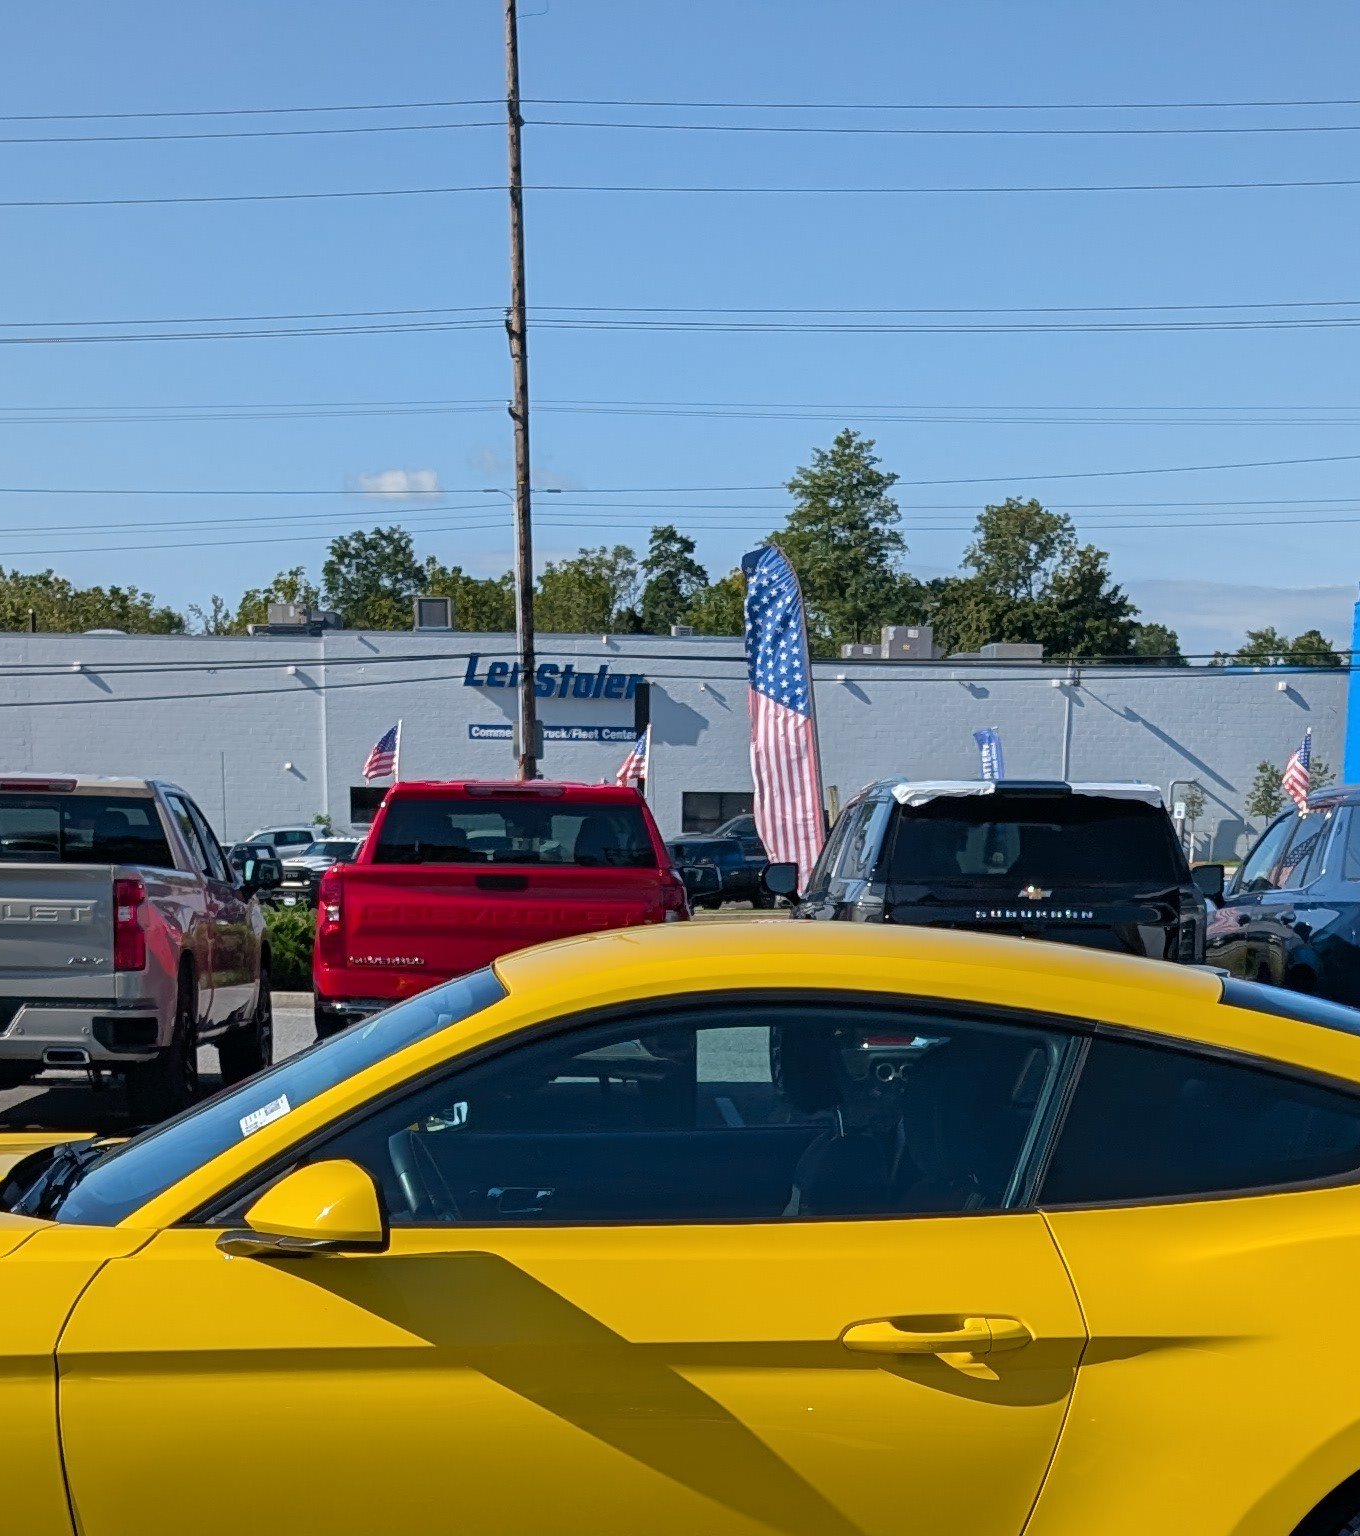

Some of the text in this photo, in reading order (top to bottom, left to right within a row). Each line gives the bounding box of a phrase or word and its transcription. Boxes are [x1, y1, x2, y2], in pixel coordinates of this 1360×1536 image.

[471, 726, 637, 741] Comme ruck/Fleet Center
[981, 743, 992, 779] ATTERY
